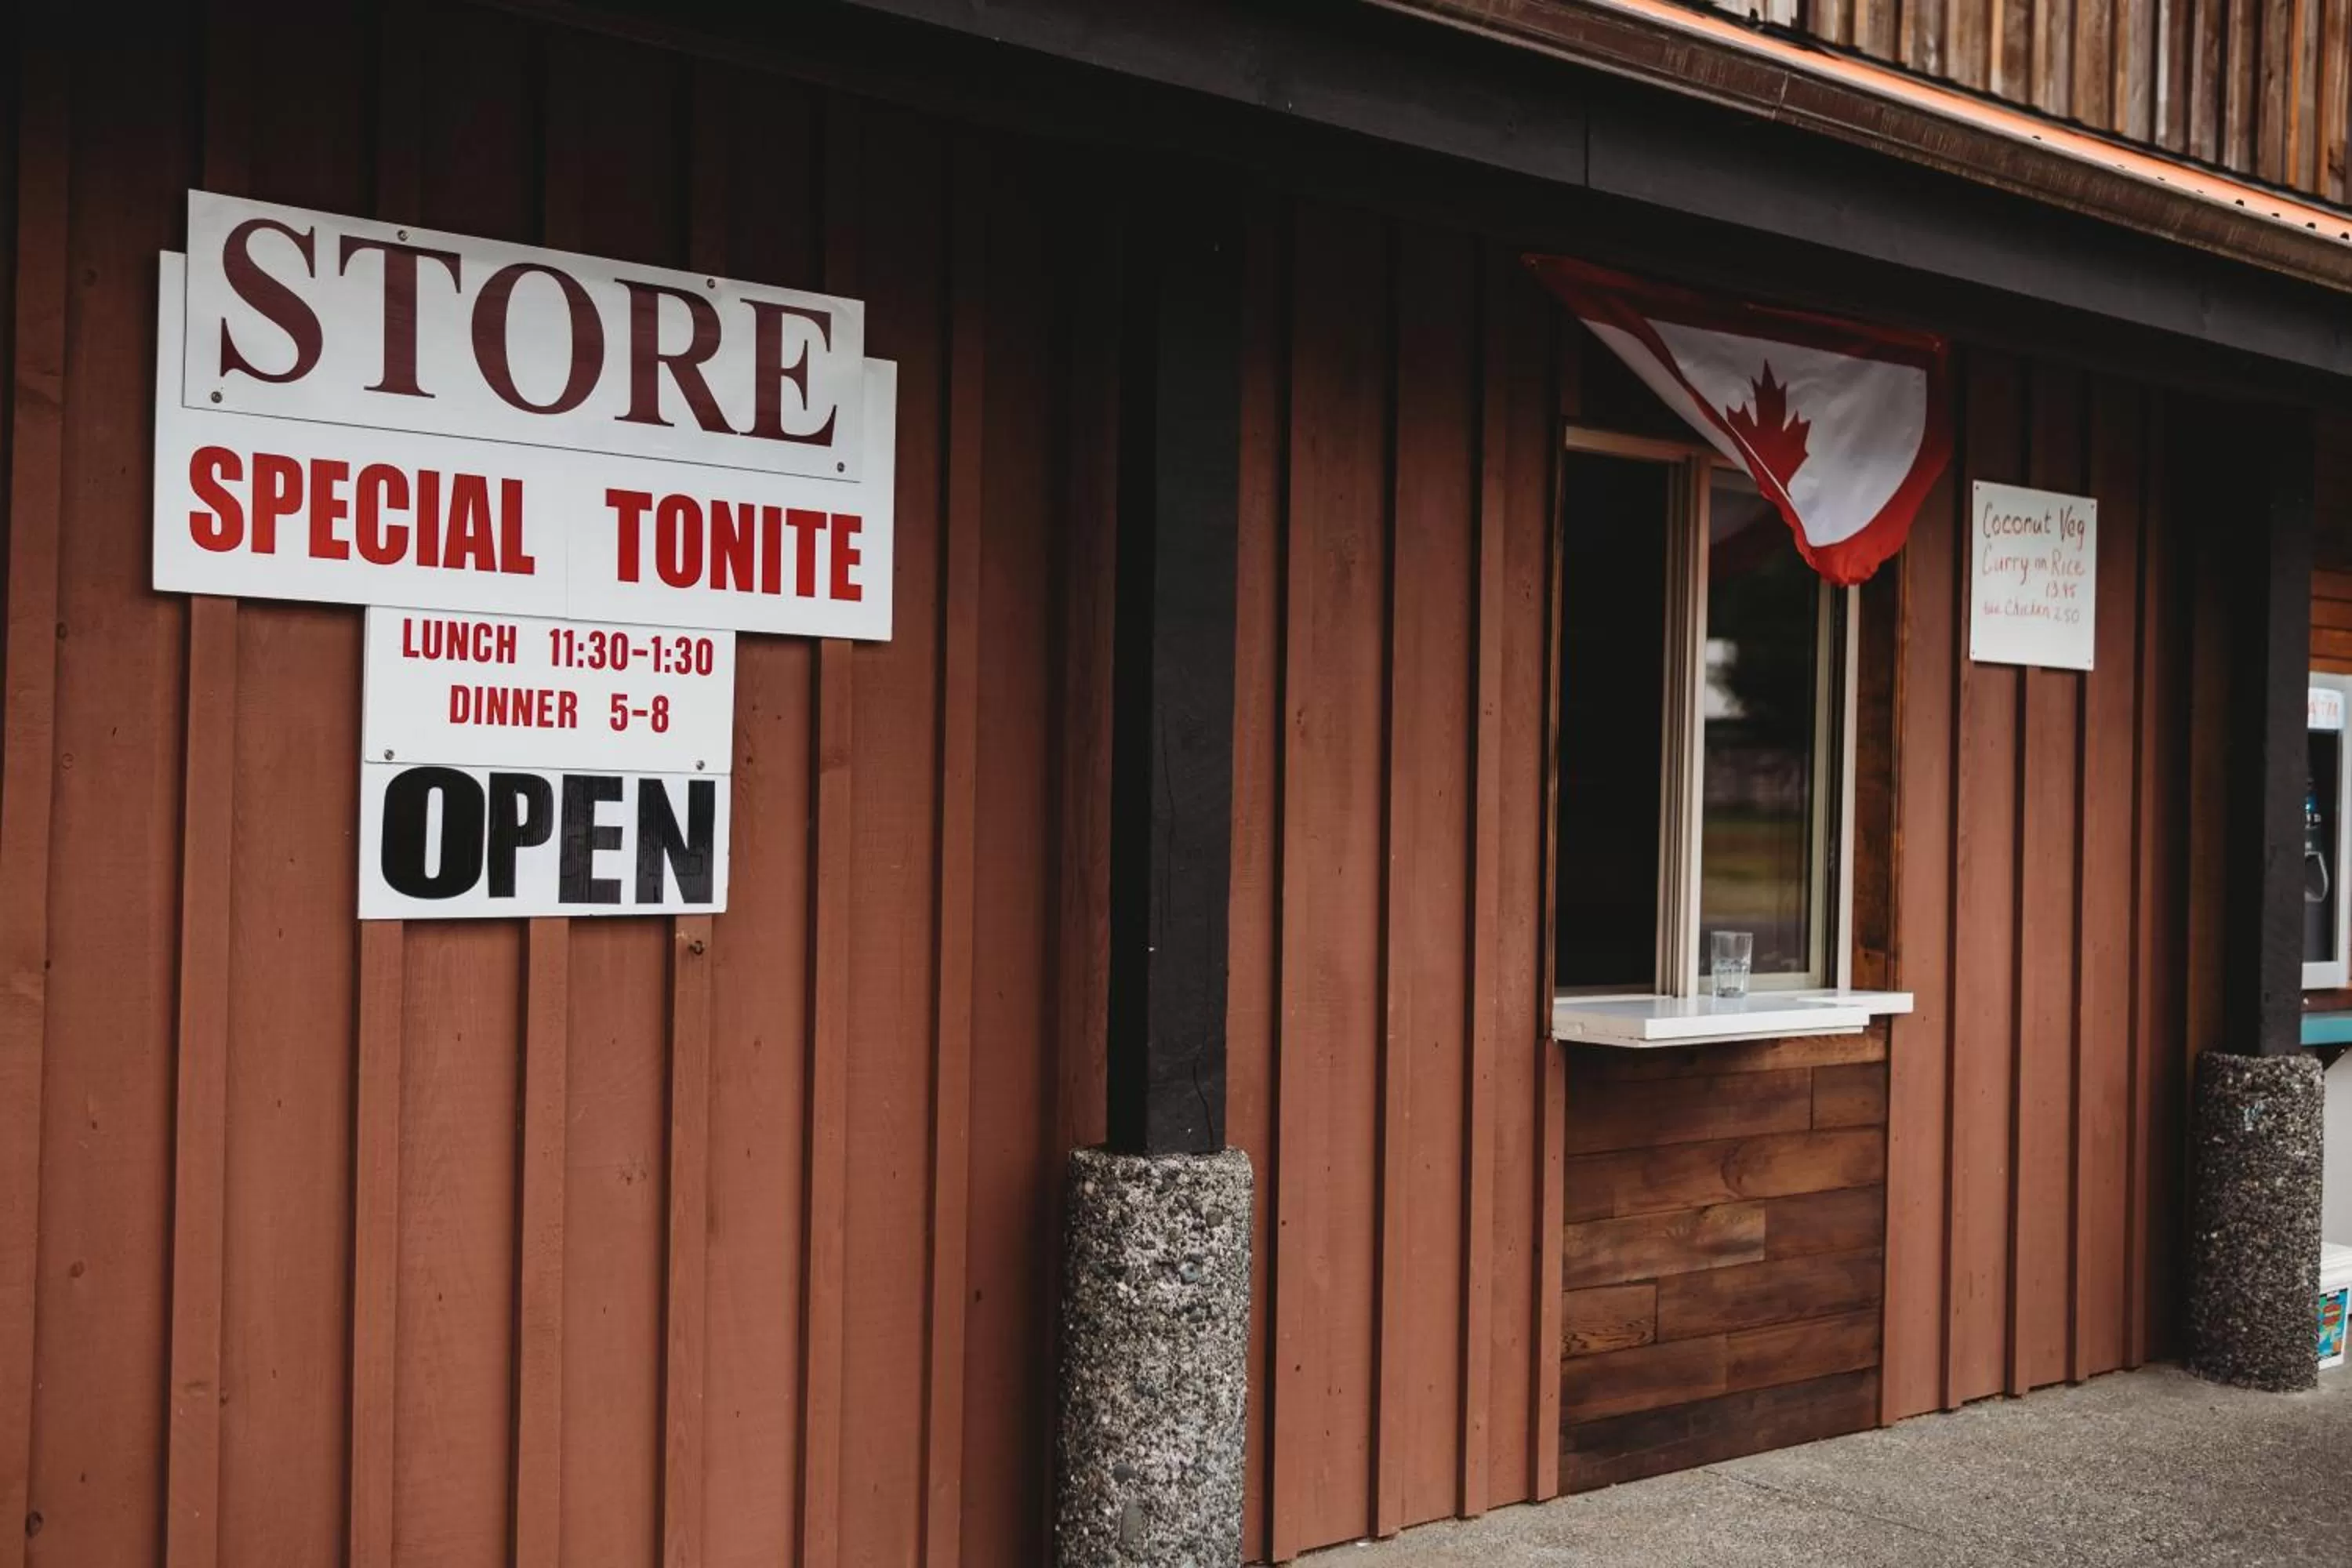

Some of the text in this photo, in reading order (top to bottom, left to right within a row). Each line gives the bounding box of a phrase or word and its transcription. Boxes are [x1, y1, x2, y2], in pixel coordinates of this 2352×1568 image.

[221, 216, 840, 448] STORE
[189, 446, 862, 602] SPECIAL TONITE
[1982, 502, 2085, 551] Coconut Veg
[1982, 543, 2029, 586] Curry
[2051, 548, 2085, 577] Rice
[402, 618, 713, 676] LUNCH 11:30-1:30
[449, 685, 670, 733] DINNER 5-8
[381, 766, 716, 904] OPEN
